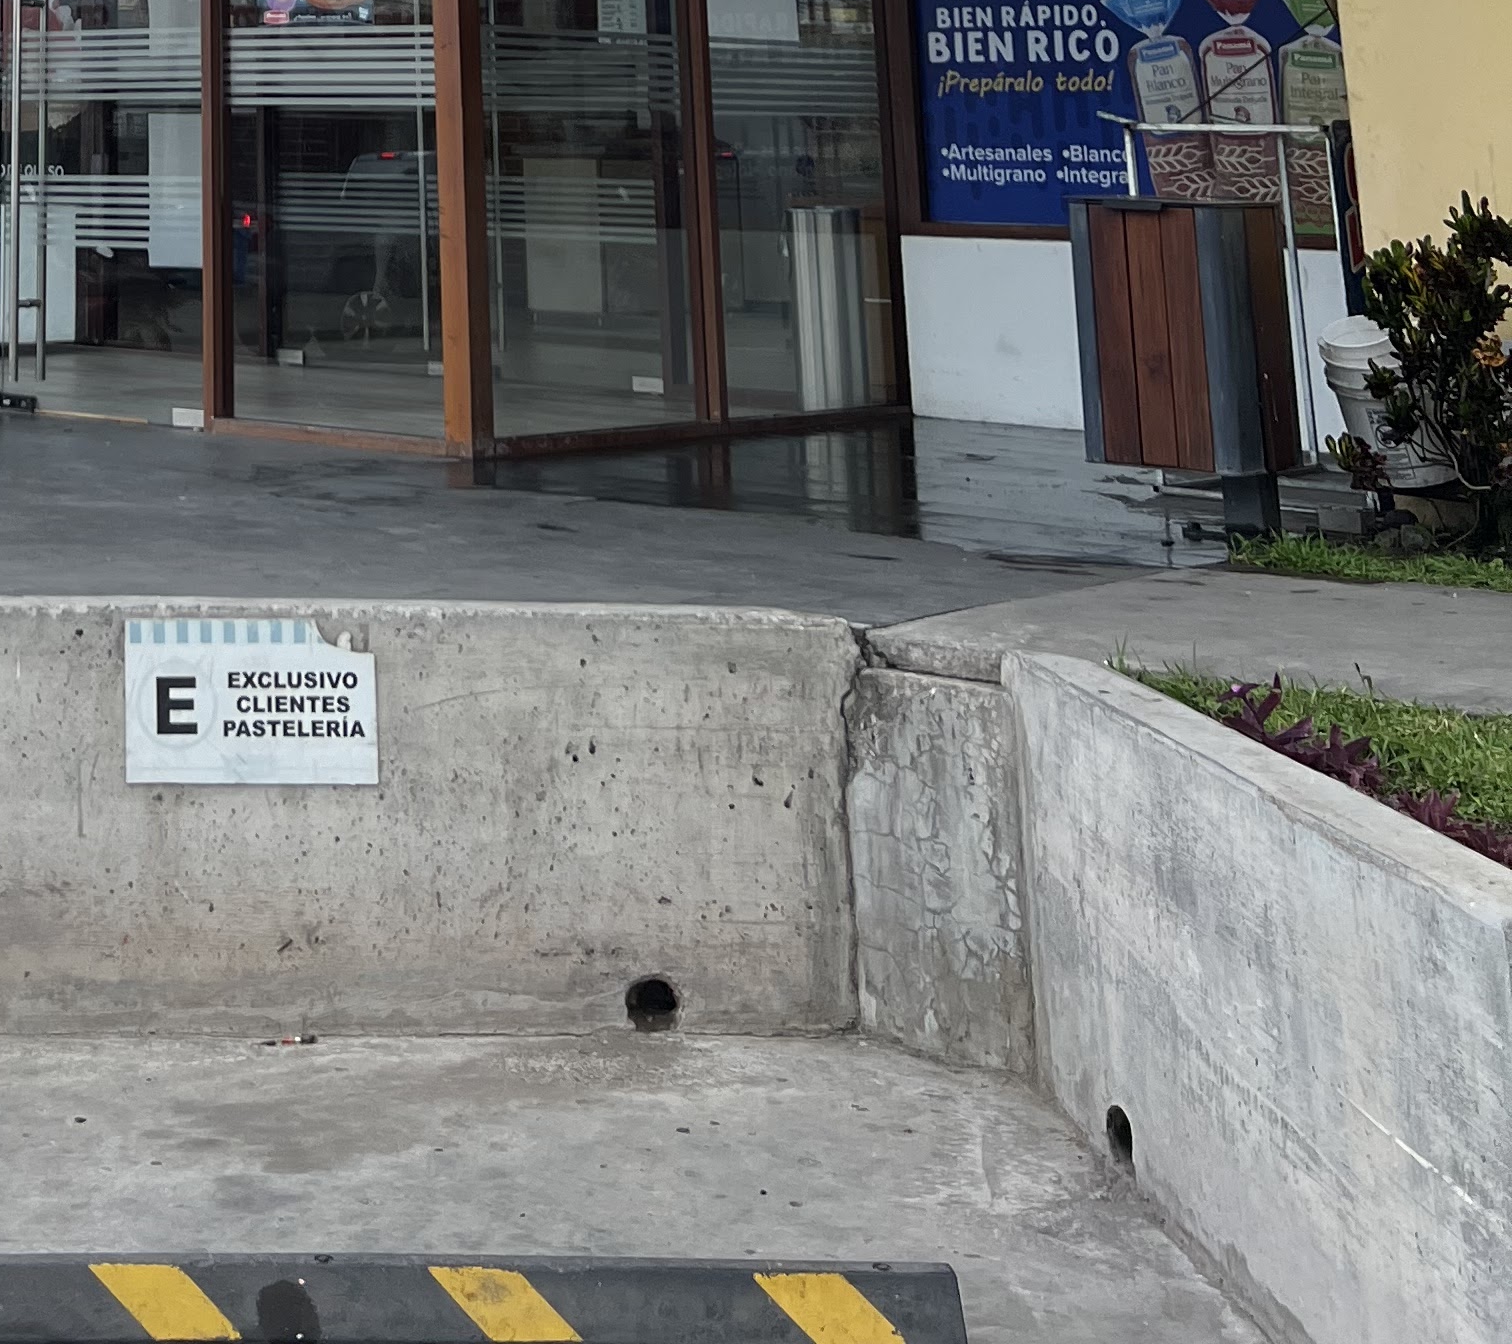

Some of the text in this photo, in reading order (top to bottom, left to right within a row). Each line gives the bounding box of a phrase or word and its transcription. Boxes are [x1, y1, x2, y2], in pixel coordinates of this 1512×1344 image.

[935, 6, 994, 29] BIEN
[927, 29, 1120, 63] BIEN RICO
[938, 68, 1115, 99] ¡Prepáralo todo!
[948, 143, 1053, 162] Artesanales
[950, 164, 1047, 186] Multigrano
[227, 672, 358, 689] EXCLUSIVO
[155, 676, 198, 735] E
[237, 696, 351, 713] CLIENTES
[223, 716, 366, 738] PASTELERÍA
